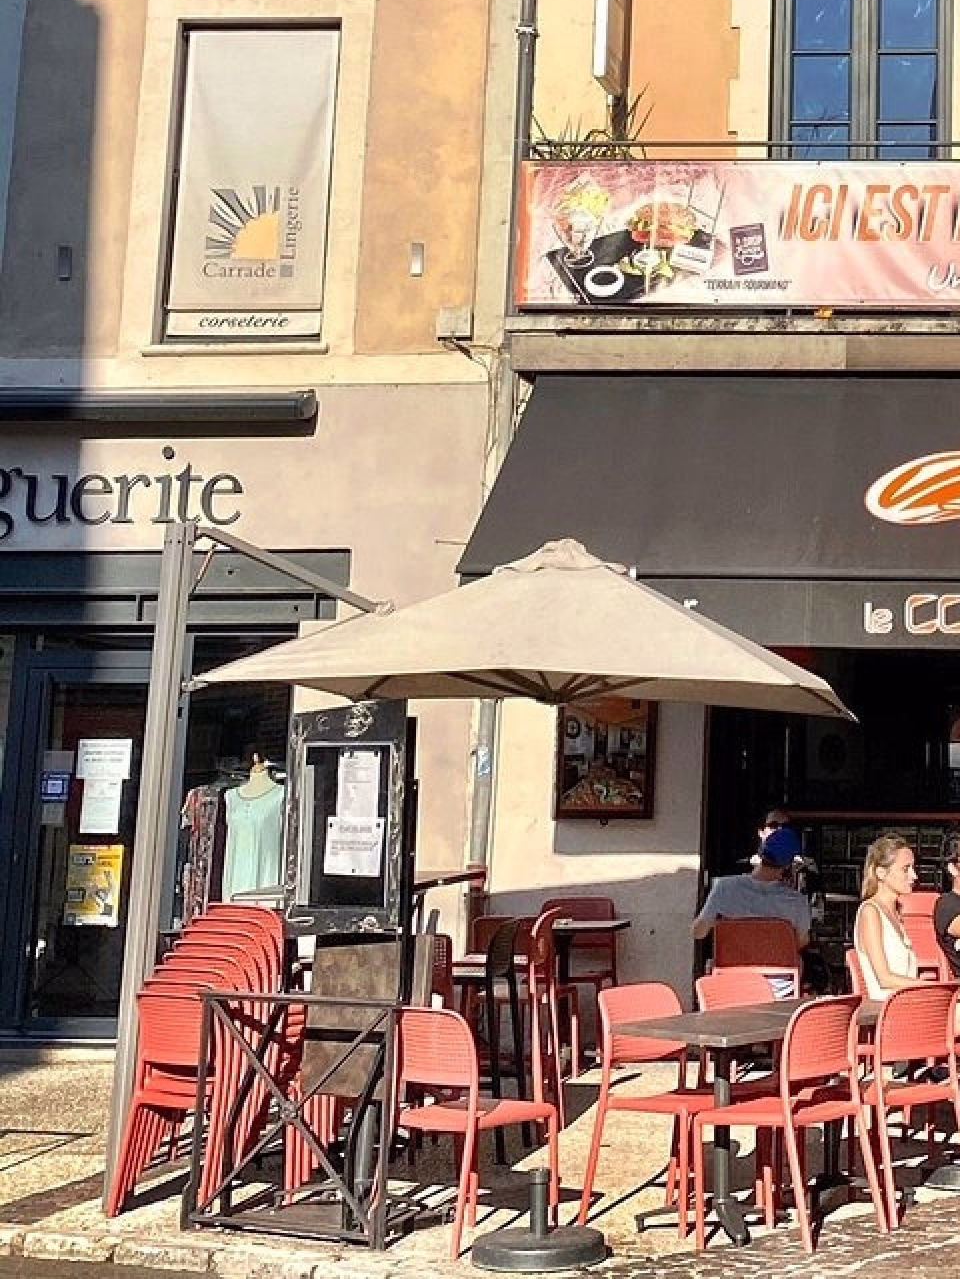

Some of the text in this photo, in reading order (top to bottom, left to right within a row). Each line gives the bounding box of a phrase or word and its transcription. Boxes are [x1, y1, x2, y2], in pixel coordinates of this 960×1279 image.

[279, 186, 303, 260] Lingerie
[781, 184, 849, 242] ICI
[856, 184, 950, 242] EST
[203, 263, 276, 278] Carrade
[863, 602, 894, 635] le
